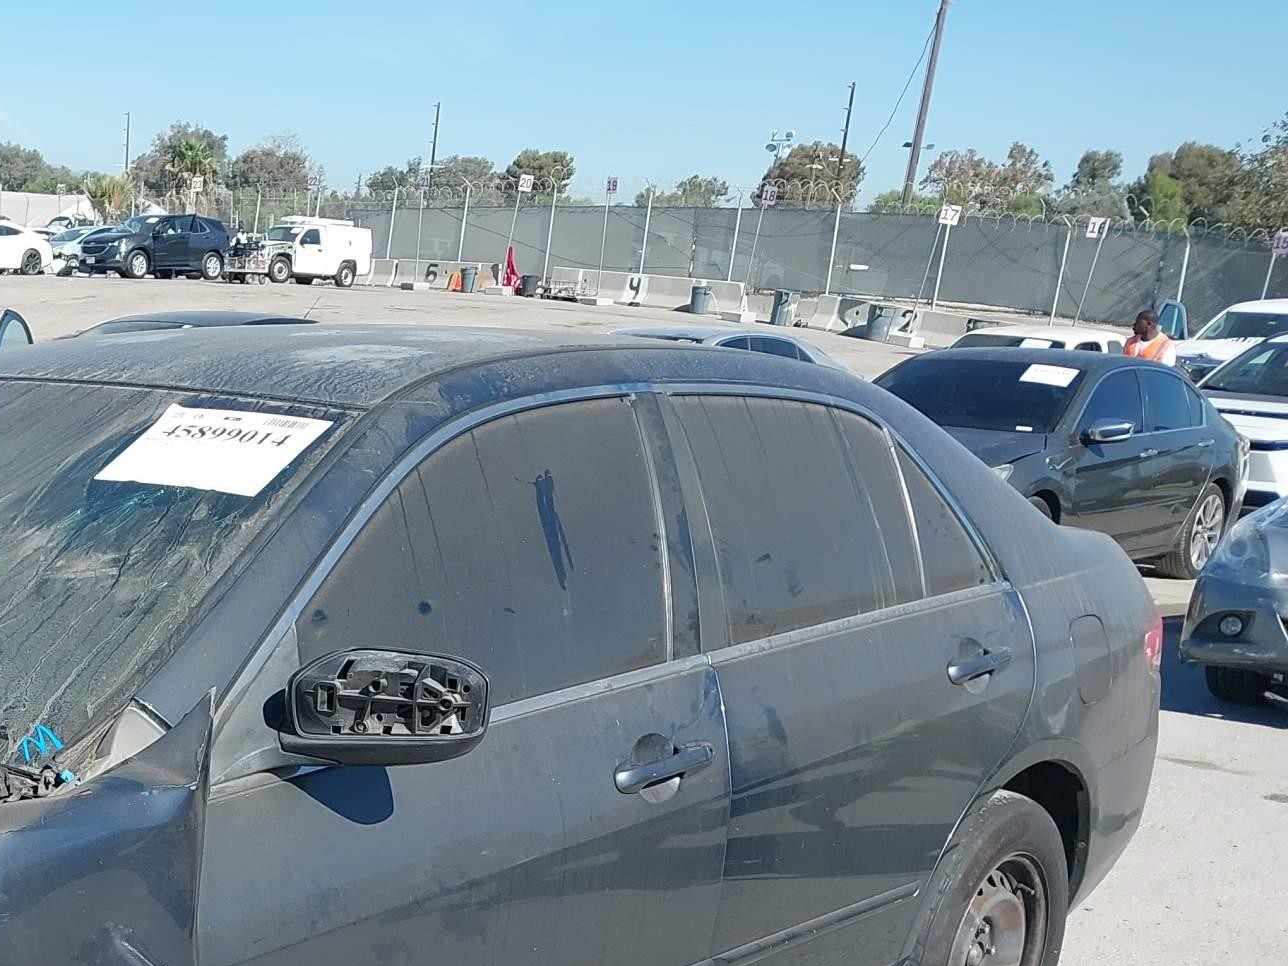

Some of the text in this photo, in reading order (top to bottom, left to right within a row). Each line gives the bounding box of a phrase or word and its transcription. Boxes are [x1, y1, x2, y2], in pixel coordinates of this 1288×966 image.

[308, 176, 318, 186] 22
[421, 178, 430, 188] 21
[519, 179, 533, 190] 20
[606, 179, 618, 191] 19
[762, 190, 776, 202] 18
[940, 208, 960, 221] 17
[424, 263, 439, 284] 6
[628, 277, 642, 300] 4
[897, 309, 918, 335] 2
[162, 424, 293, 447] 45899014
